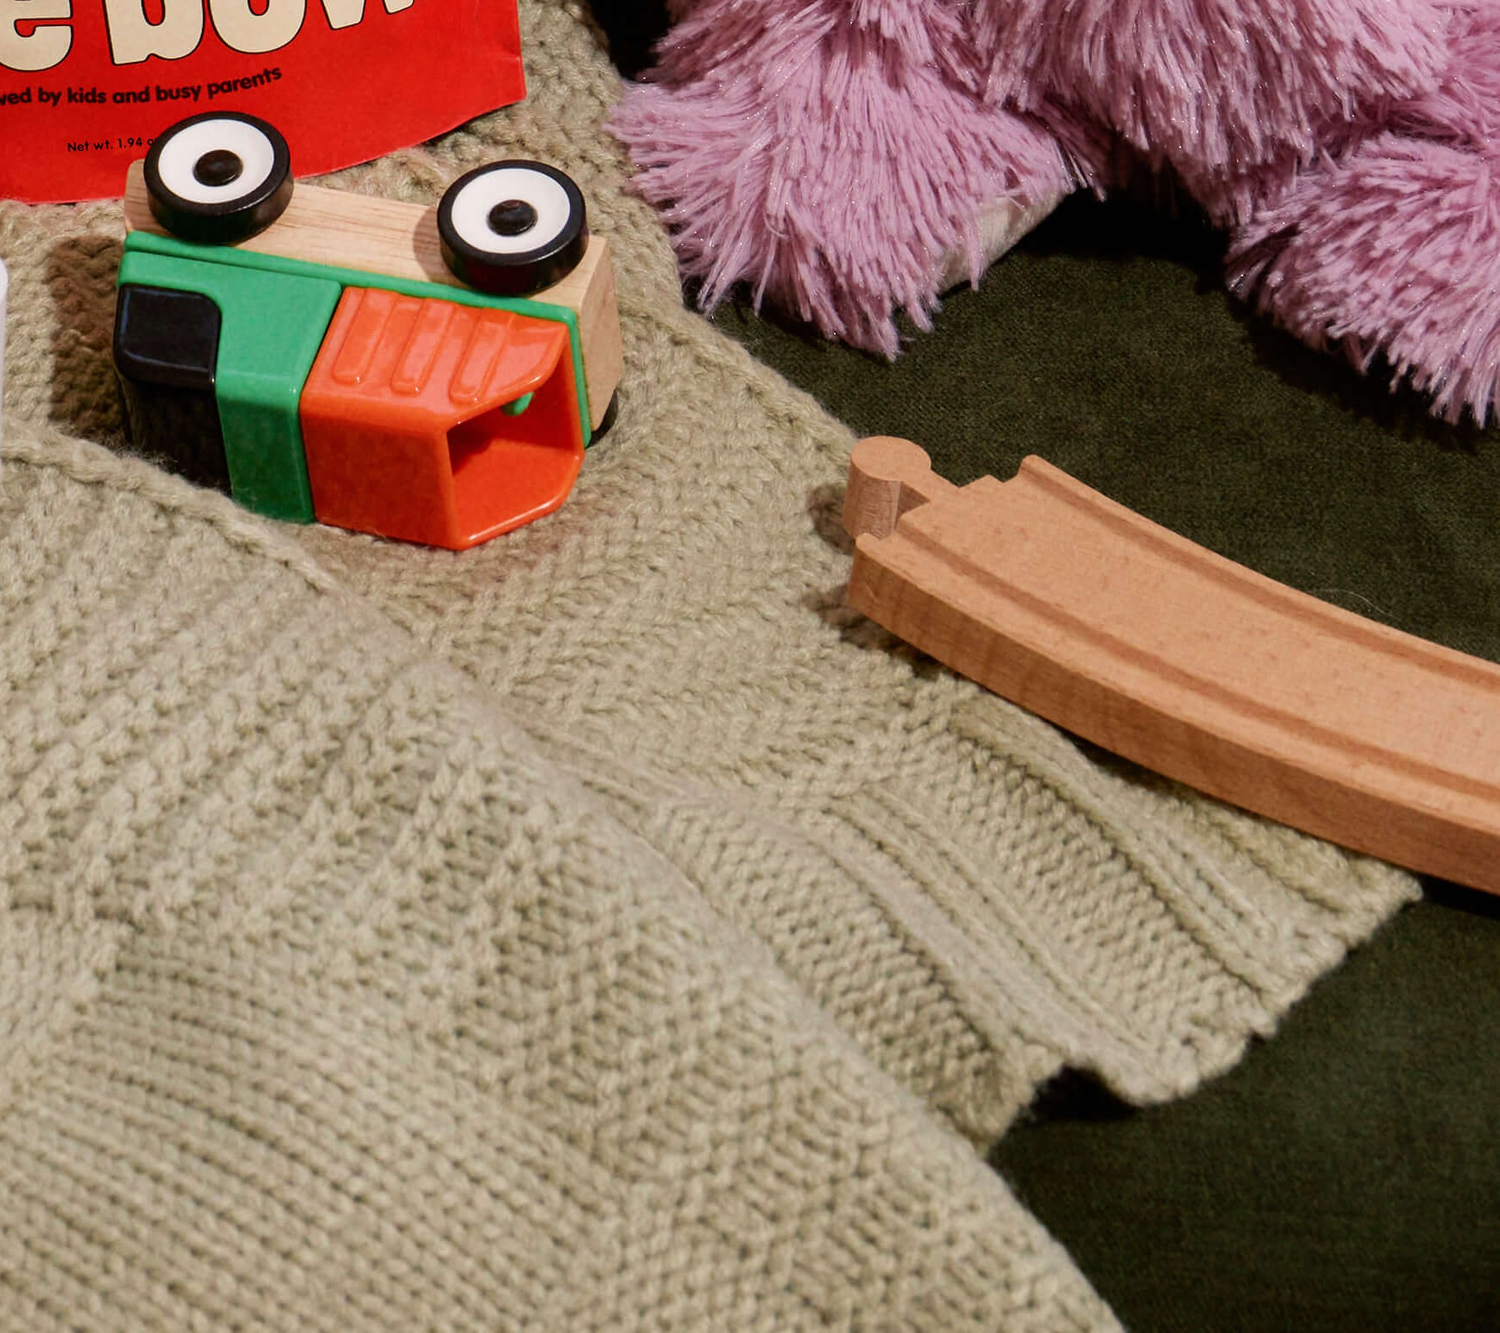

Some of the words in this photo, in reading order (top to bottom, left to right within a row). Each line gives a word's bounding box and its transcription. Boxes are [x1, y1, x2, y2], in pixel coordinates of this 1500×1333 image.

[38, 87, 62, 107] by
[67, 87, 107, 104] kids
[112, 86, 150, 104] and
[155, 83, 201, 102] busy
[207, 67, 282, 99] parents
[67, 141, 89, 152] Net
[118, 137, 143, 149] 1.94
